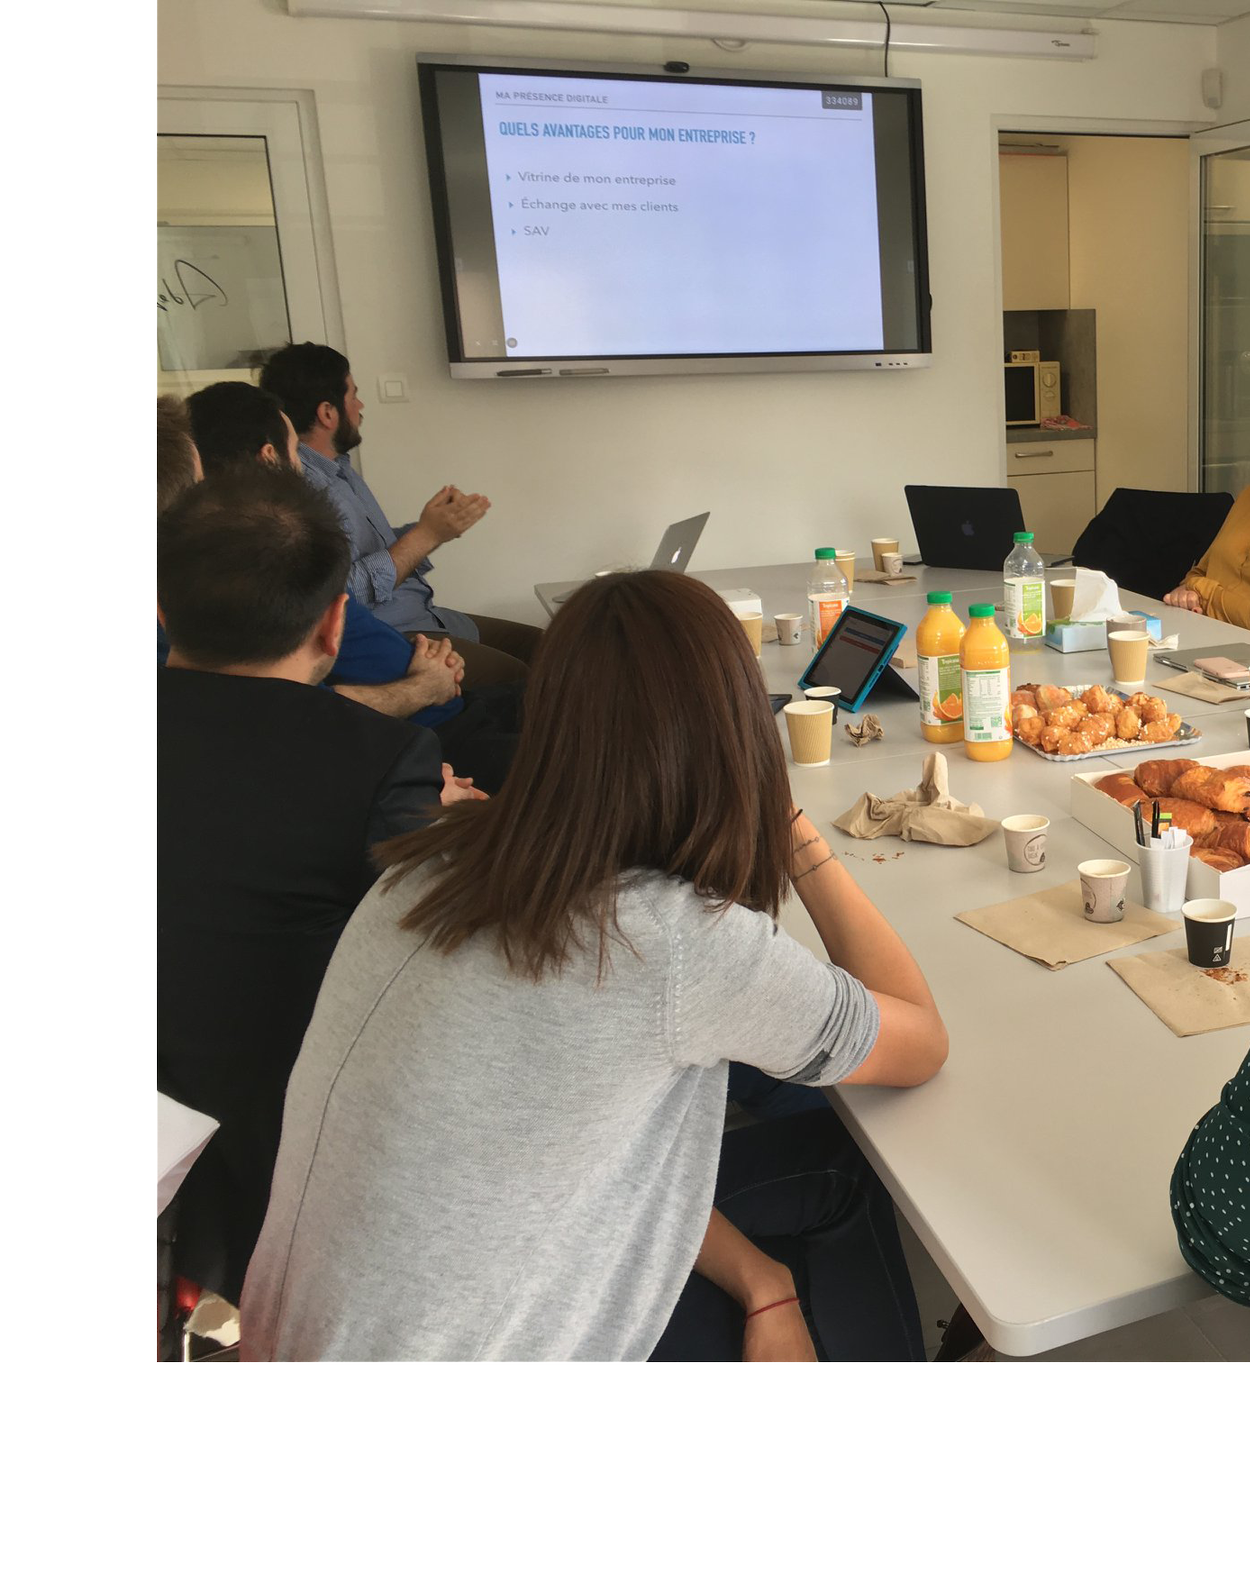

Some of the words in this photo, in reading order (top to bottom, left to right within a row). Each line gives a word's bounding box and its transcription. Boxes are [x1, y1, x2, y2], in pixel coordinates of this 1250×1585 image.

[495, 91, 511, 99] MA
[513, 91, 563, 102] PRÉSENCE
[566, 95, 608, 103] DIGITALE
[499, 121, 539, 137] QUELS
[543, 123, 610, 139] AVANTAGES
[613, 126, 645, 140] POUR
[648, 127, 675, 141] MON
[678, 128, 747, 144] ENTREPRISE
[749, 131, 756, 144] ?
[518, 171, 560, 183] Vitrine
[563, 172, 580, 184] de
[583, 175, 612, 185] mon
[615, 175, 677, 187] entreprise
[521, 196, 577, 213] Échange
[580, 203, 608, 211] avec
[611, 204, 637, 212] mes
[640, 201, 679, 213] clients
[524, 225, 550, 237] SAV
